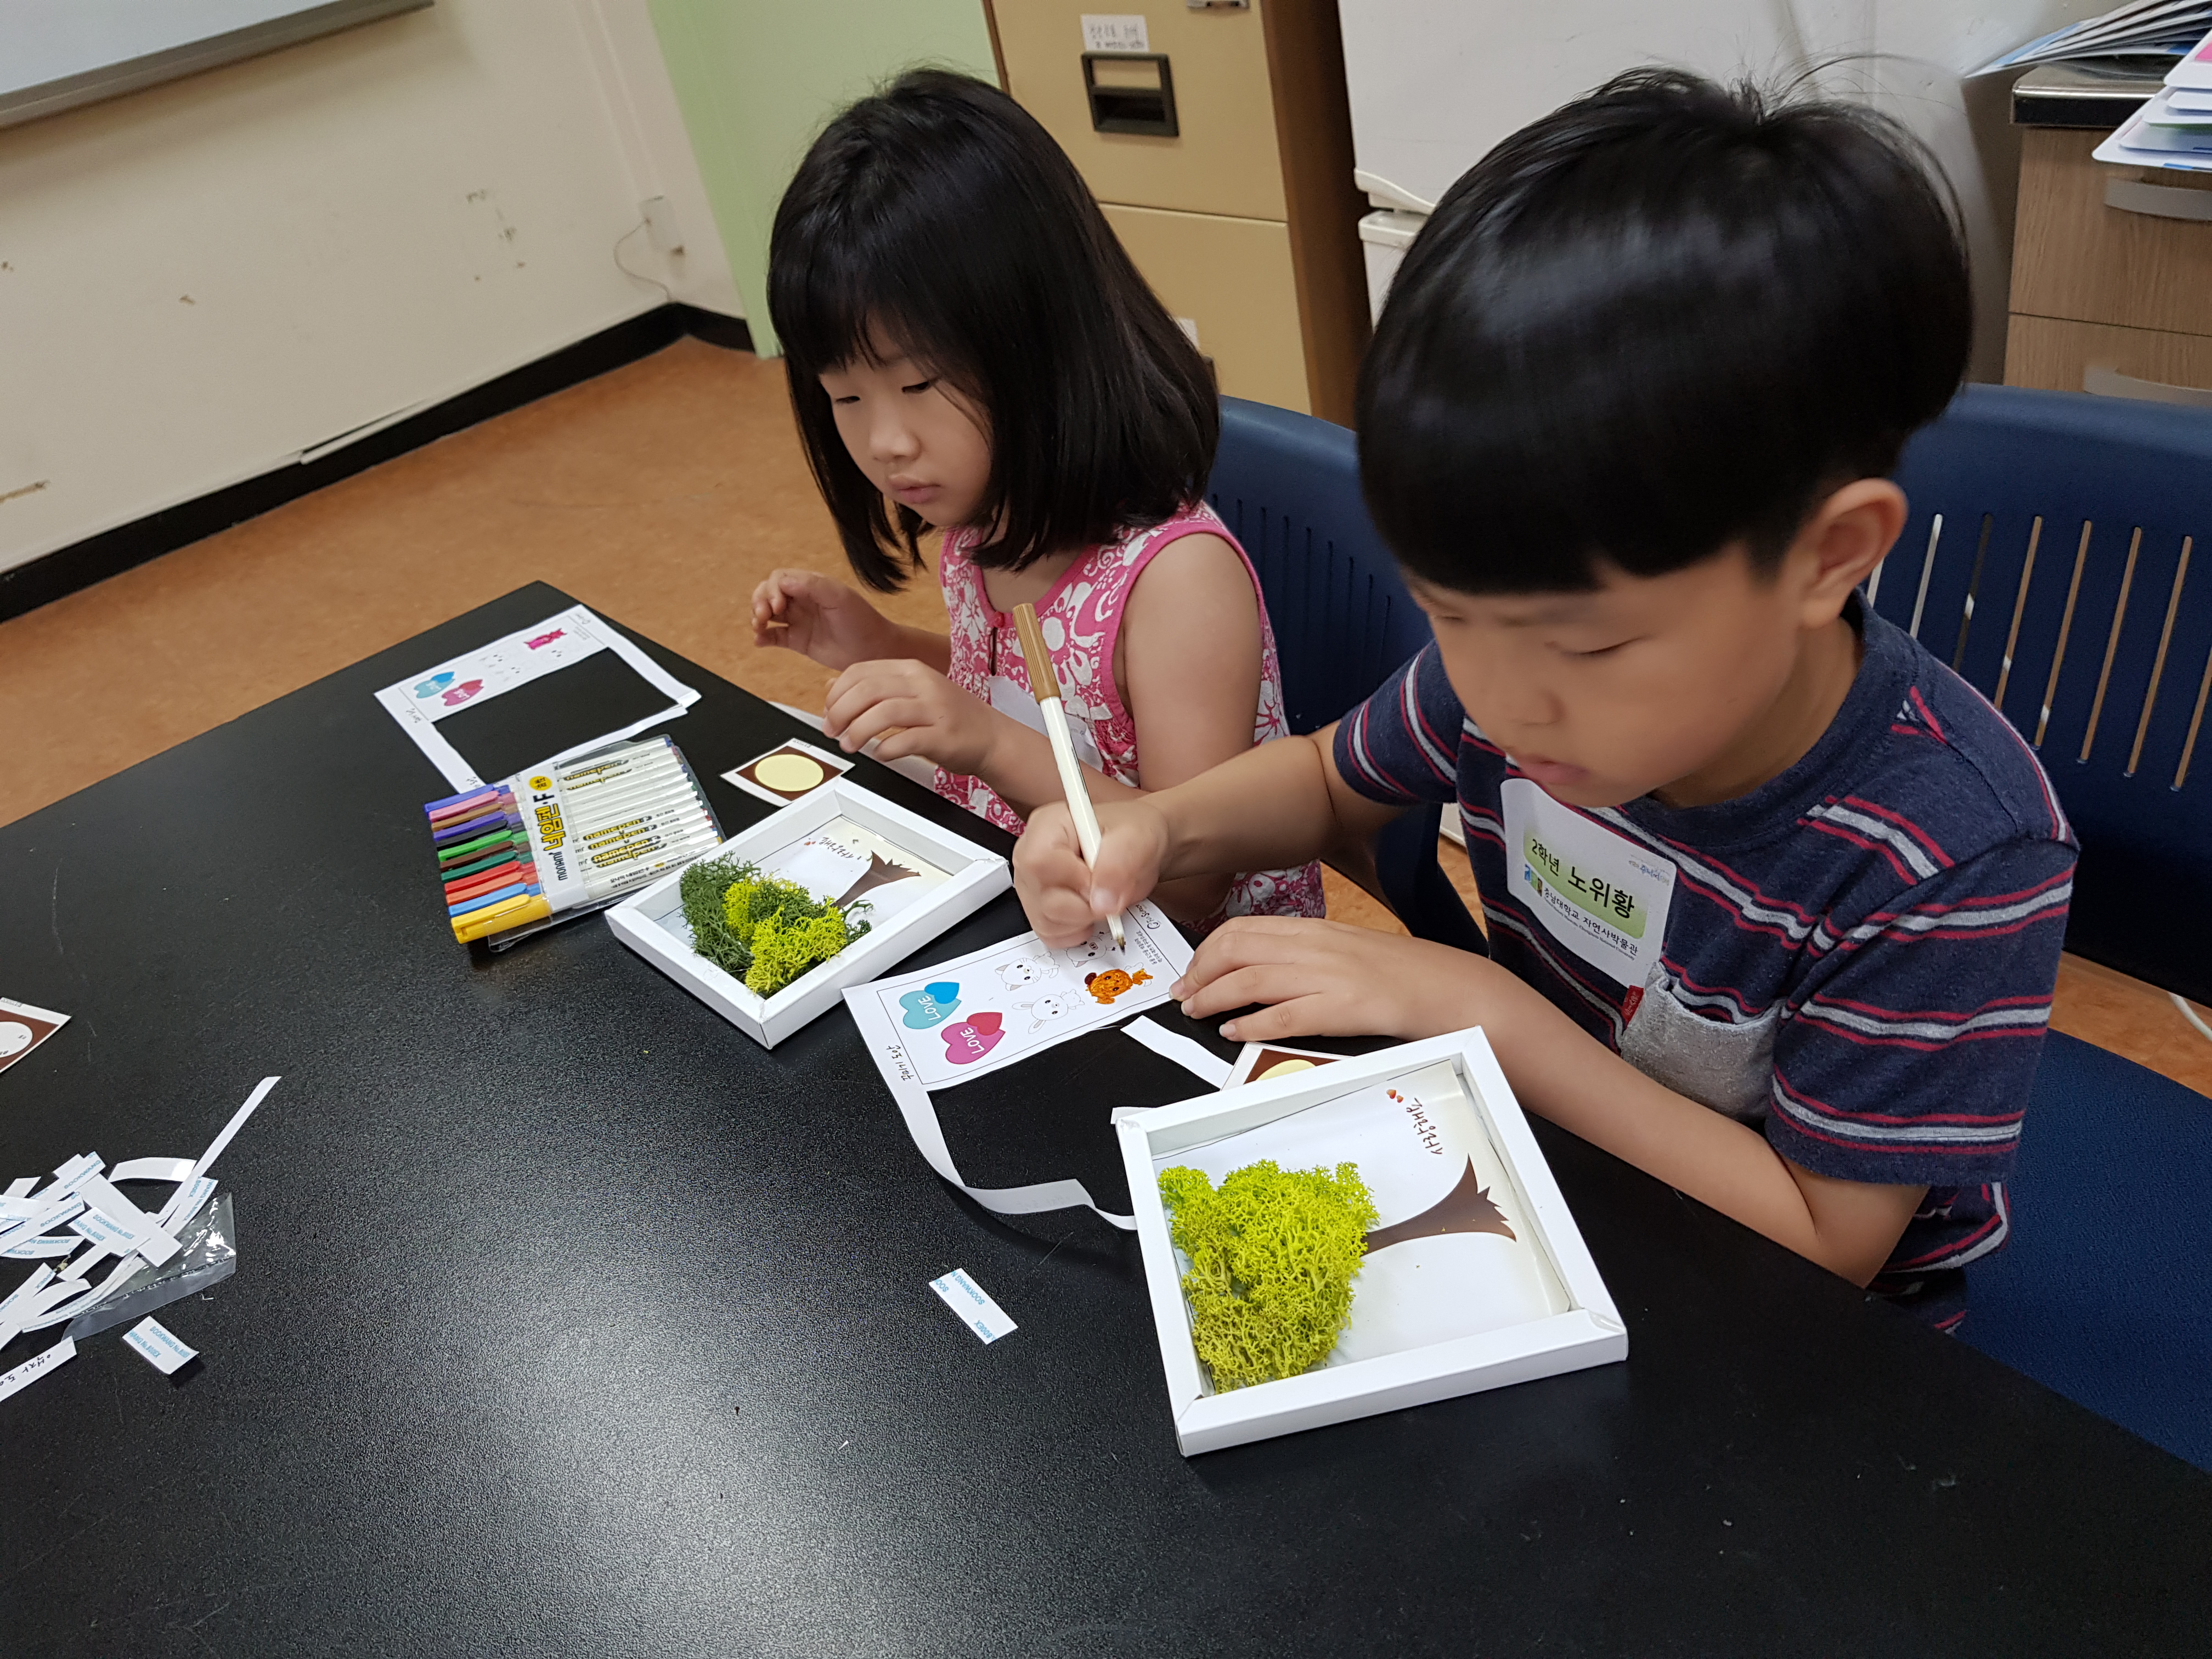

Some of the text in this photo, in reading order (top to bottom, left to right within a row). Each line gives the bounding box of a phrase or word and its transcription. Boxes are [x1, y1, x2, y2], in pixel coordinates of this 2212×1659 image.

[585, 819, 641, 840] namepen
[591, 828, 646, 849] namepen
[594, 839, 649, 862] namepen
[819, 837, 854, 858] 사랑해요
[1532, 838, 1635, 919] 2학년 노위황
[1544, 888, 1638, 956] 충남대학교 자연사박물관
[918, 995, 941, 1020] LOVE
[960, 1028, 985, 1054] LOVE
[886, 1045, 915, 1081] 꾸미기 도안
[1406, 1097, 1442, 1154] 사랑해요
[956, 1275, 985, 1305] SOOKWANG
[22, 1354, 50, 1373] 액자
